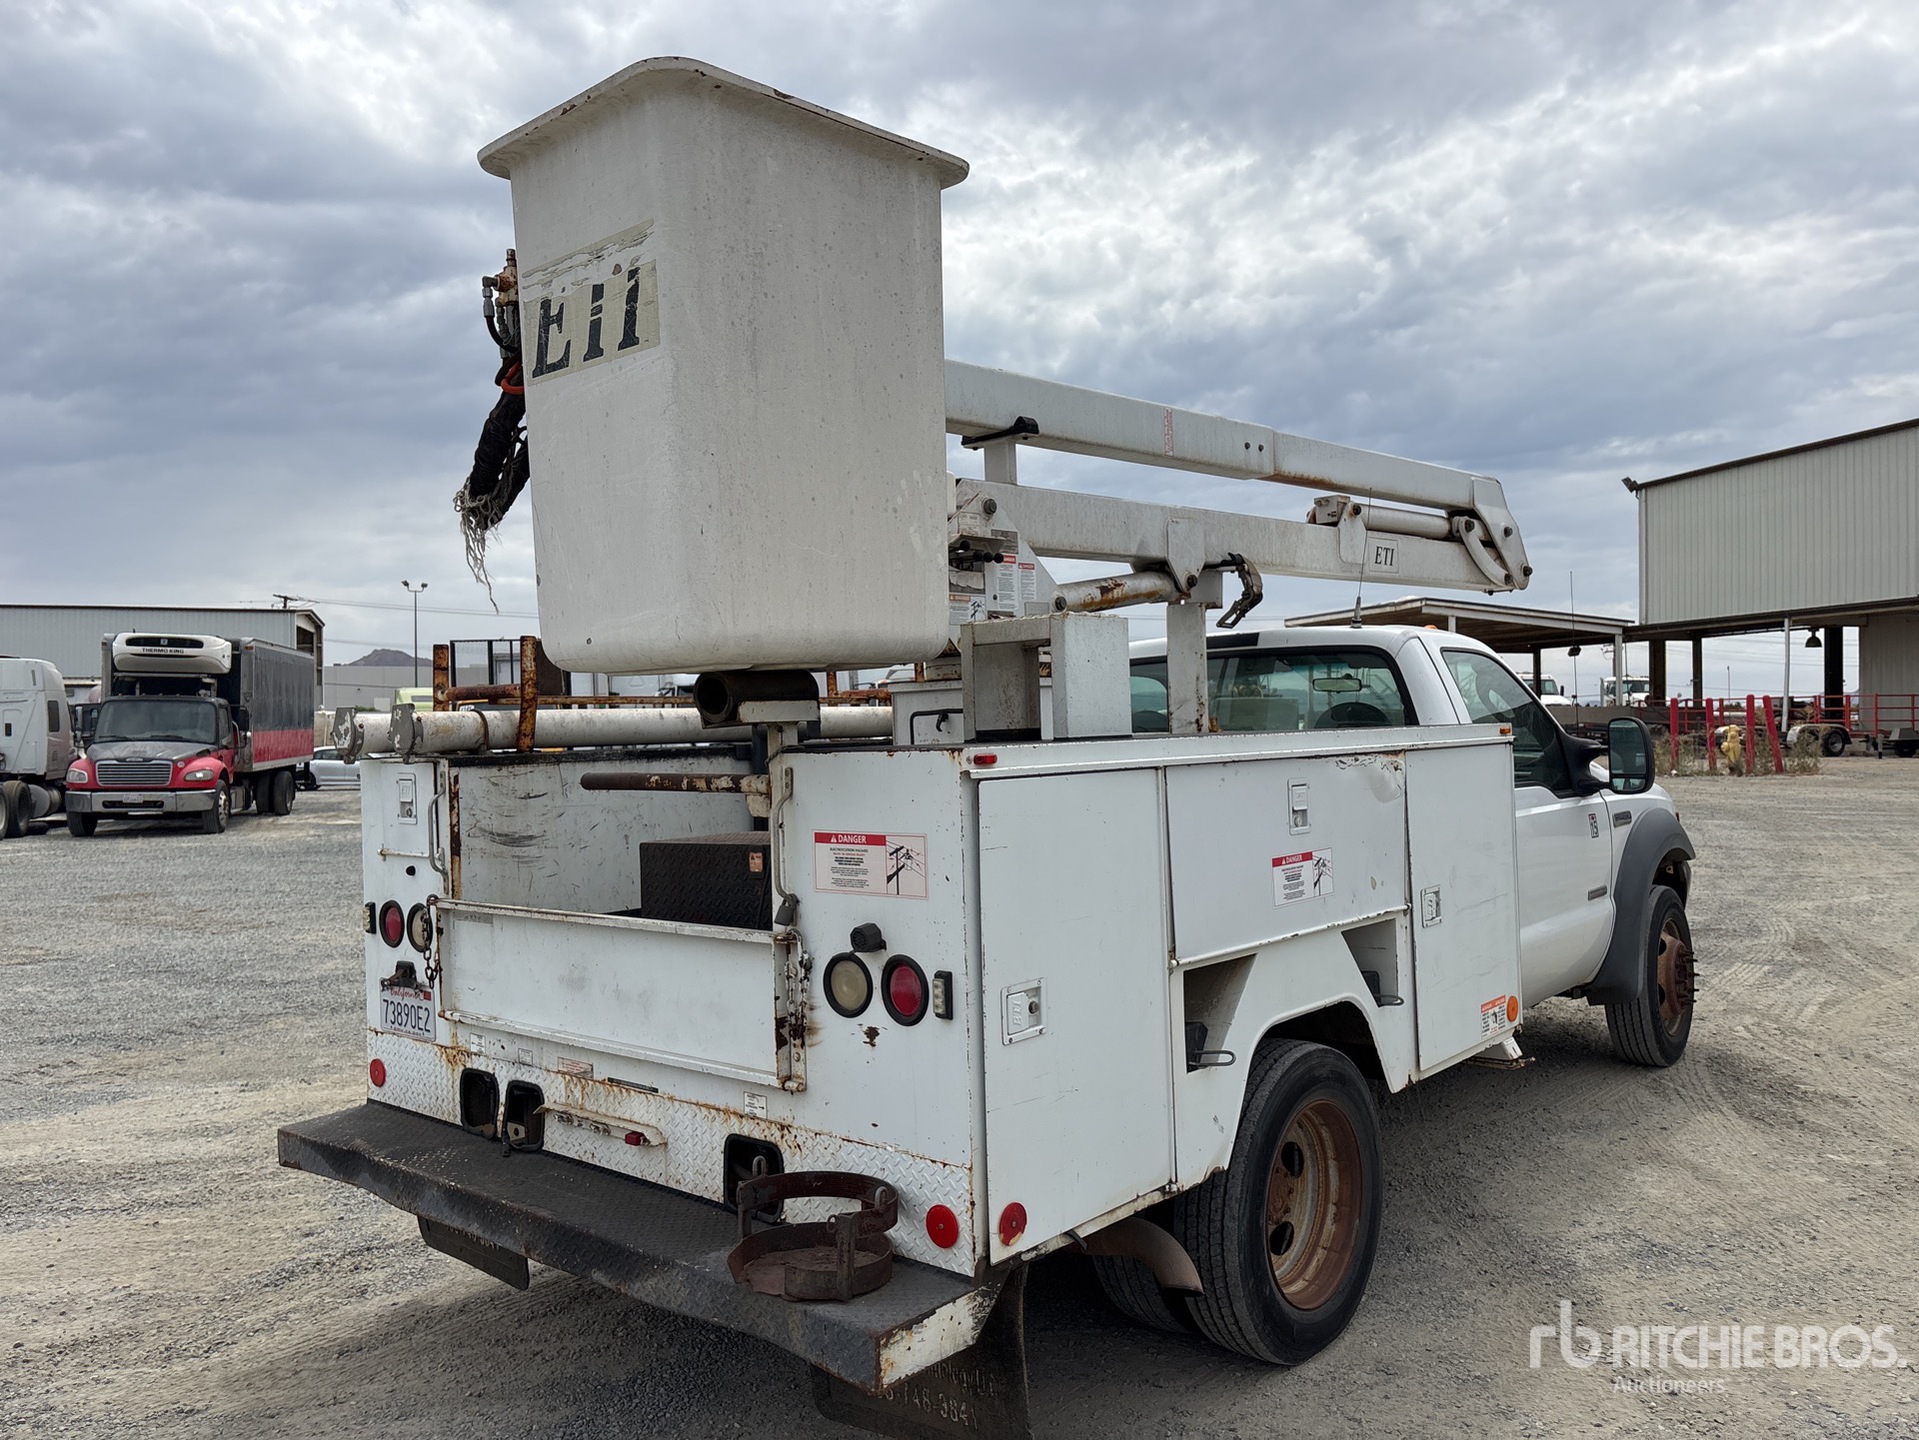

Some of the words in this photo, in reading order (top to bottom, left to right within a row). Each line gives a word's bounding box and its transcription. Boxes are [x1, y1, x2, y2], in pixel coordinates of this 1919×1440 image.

[1374, 545, 1395, 567] ETI
[838, 834, 867, 844] DANGER
[382, 998, 431, 1033] 73890E2
